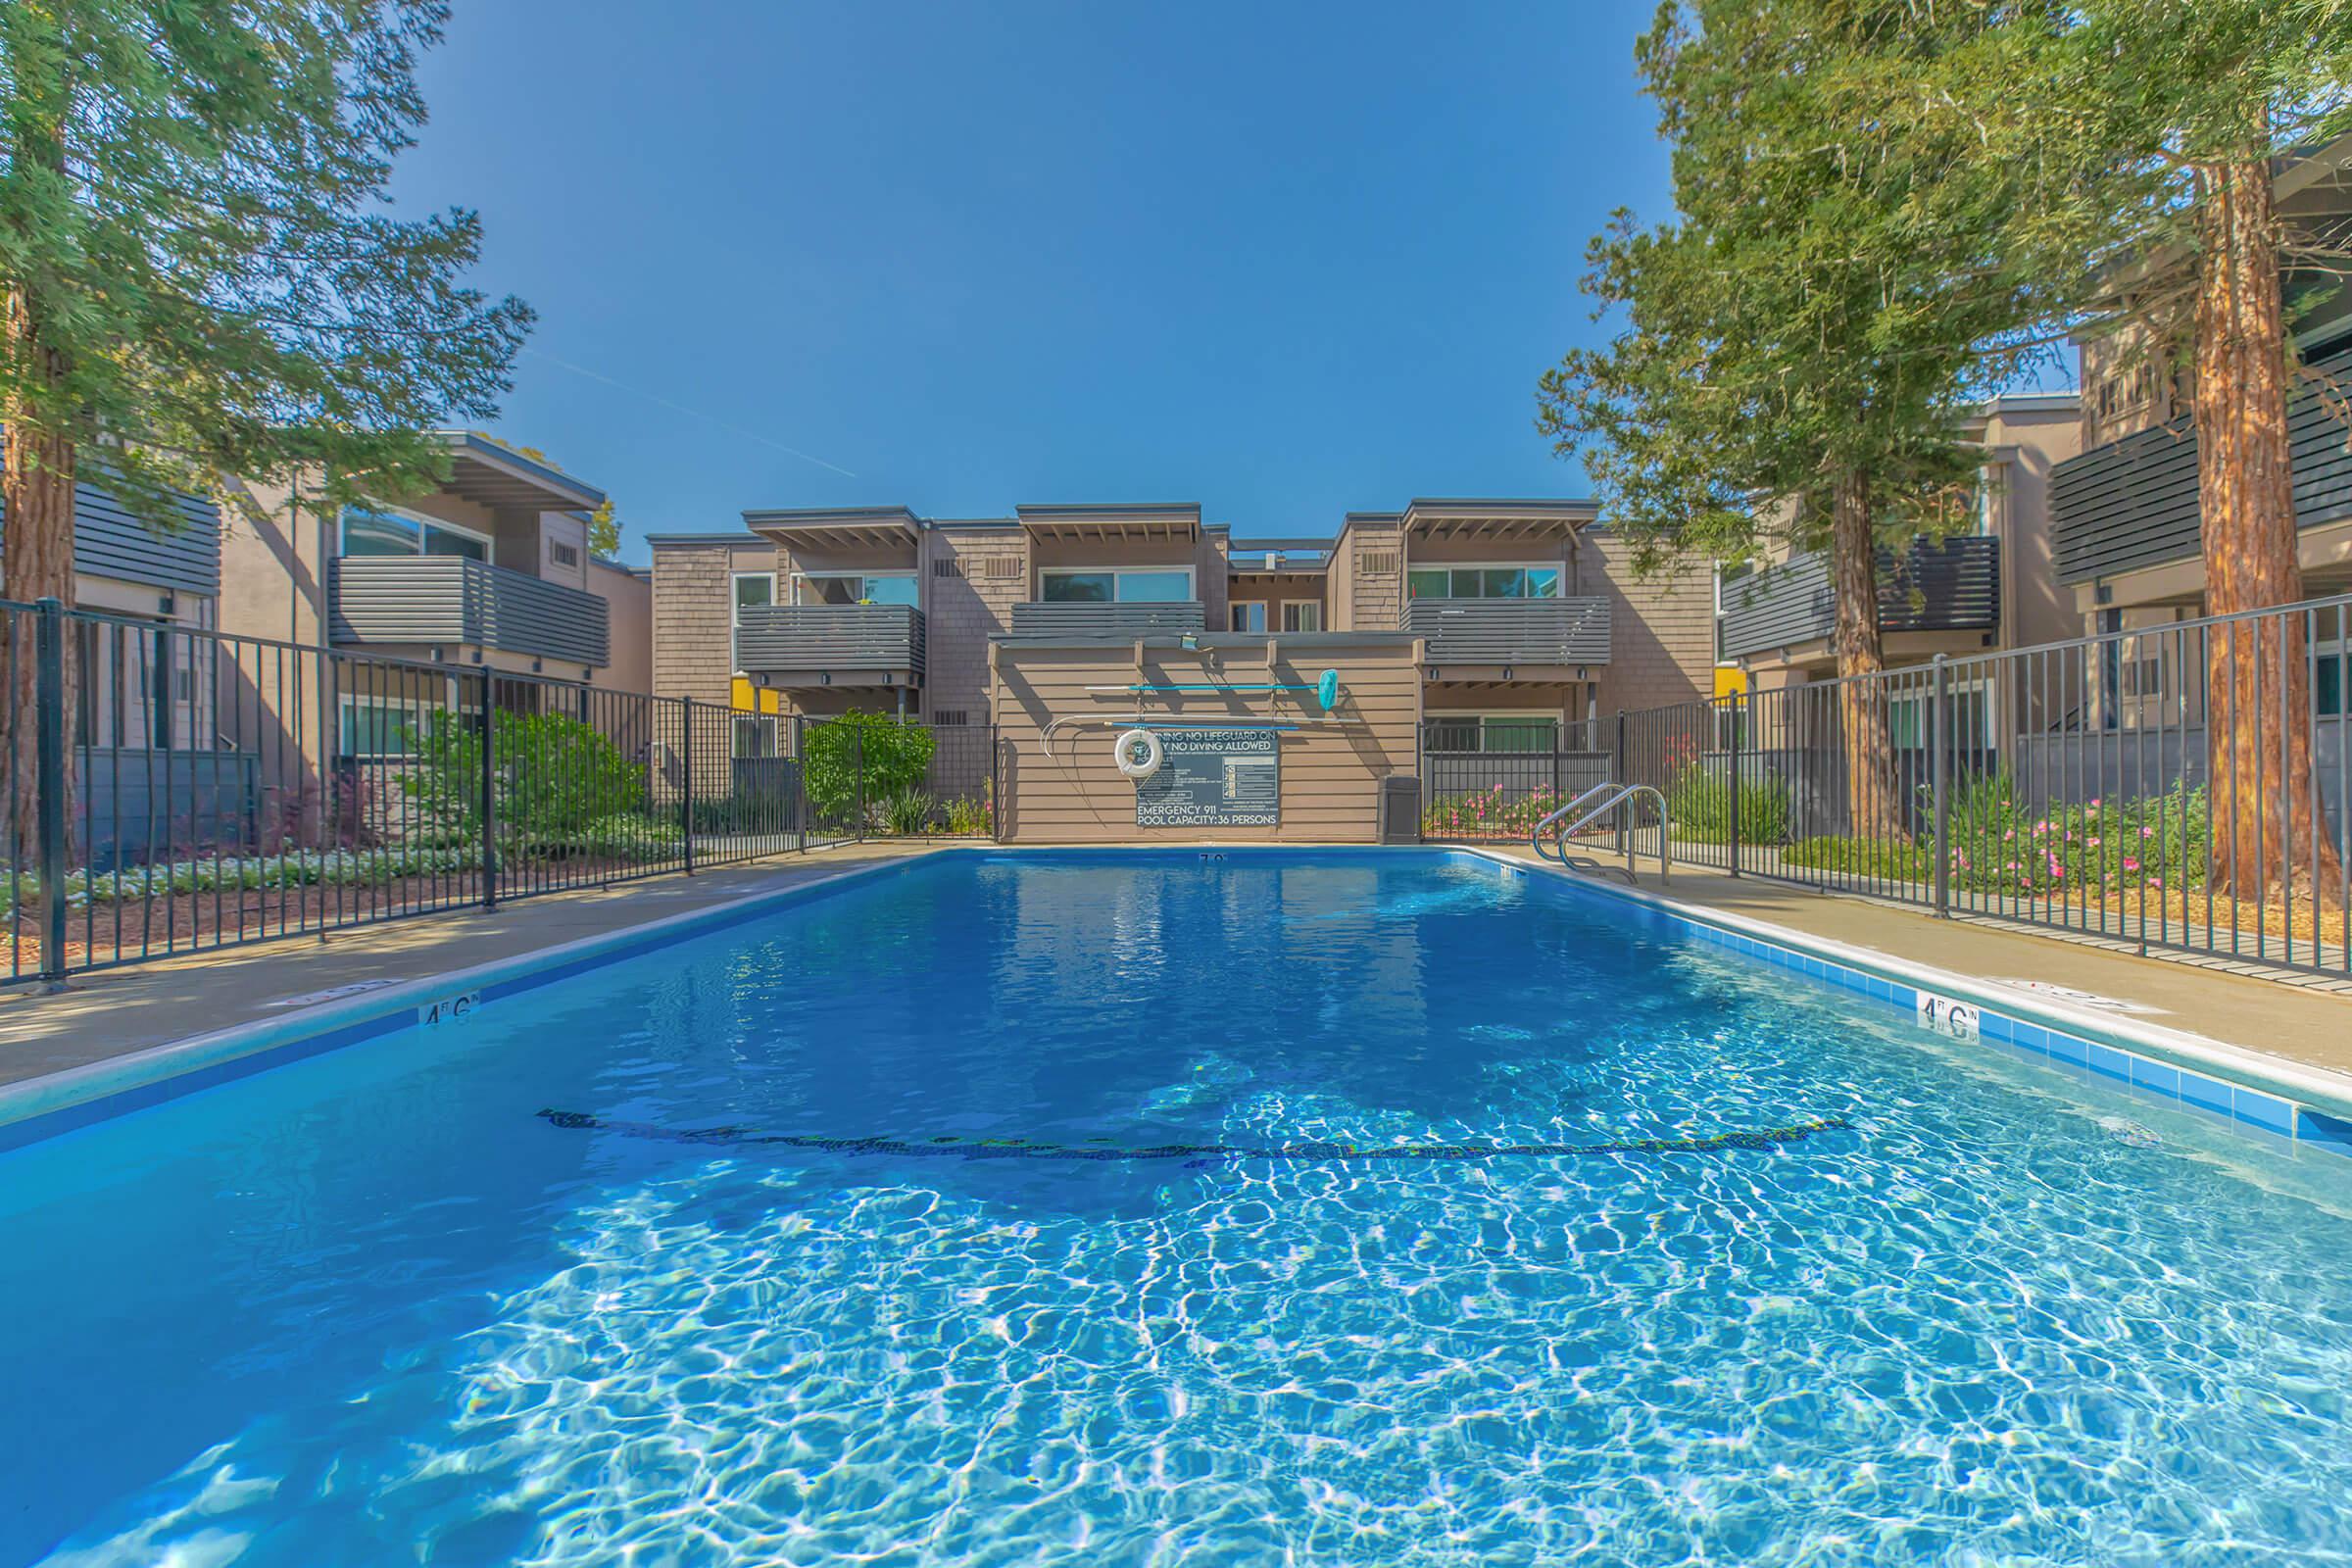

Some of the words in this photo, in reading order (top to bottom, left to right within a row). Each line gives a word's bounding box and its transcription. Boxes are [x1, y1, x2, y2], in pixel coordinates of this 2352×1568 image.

[1187, 731, 1202, 742] NO
[1204, 731, 1257, 741] LIFEGUARD
[1259, 730, 1276, 740] ON
[1171, 742, 1188, 752] NO
[1190, 742, 1223, 752] DIVING
[1224, 741, 1271, 751] ALLOWED
[1138, 806, 1200, 815] EMERGENCY
[1203, 806, 1217, 815] 911
[1138, 815, 1166, 825] POOL
[1231, 814, 1277, 824] PERSONS
